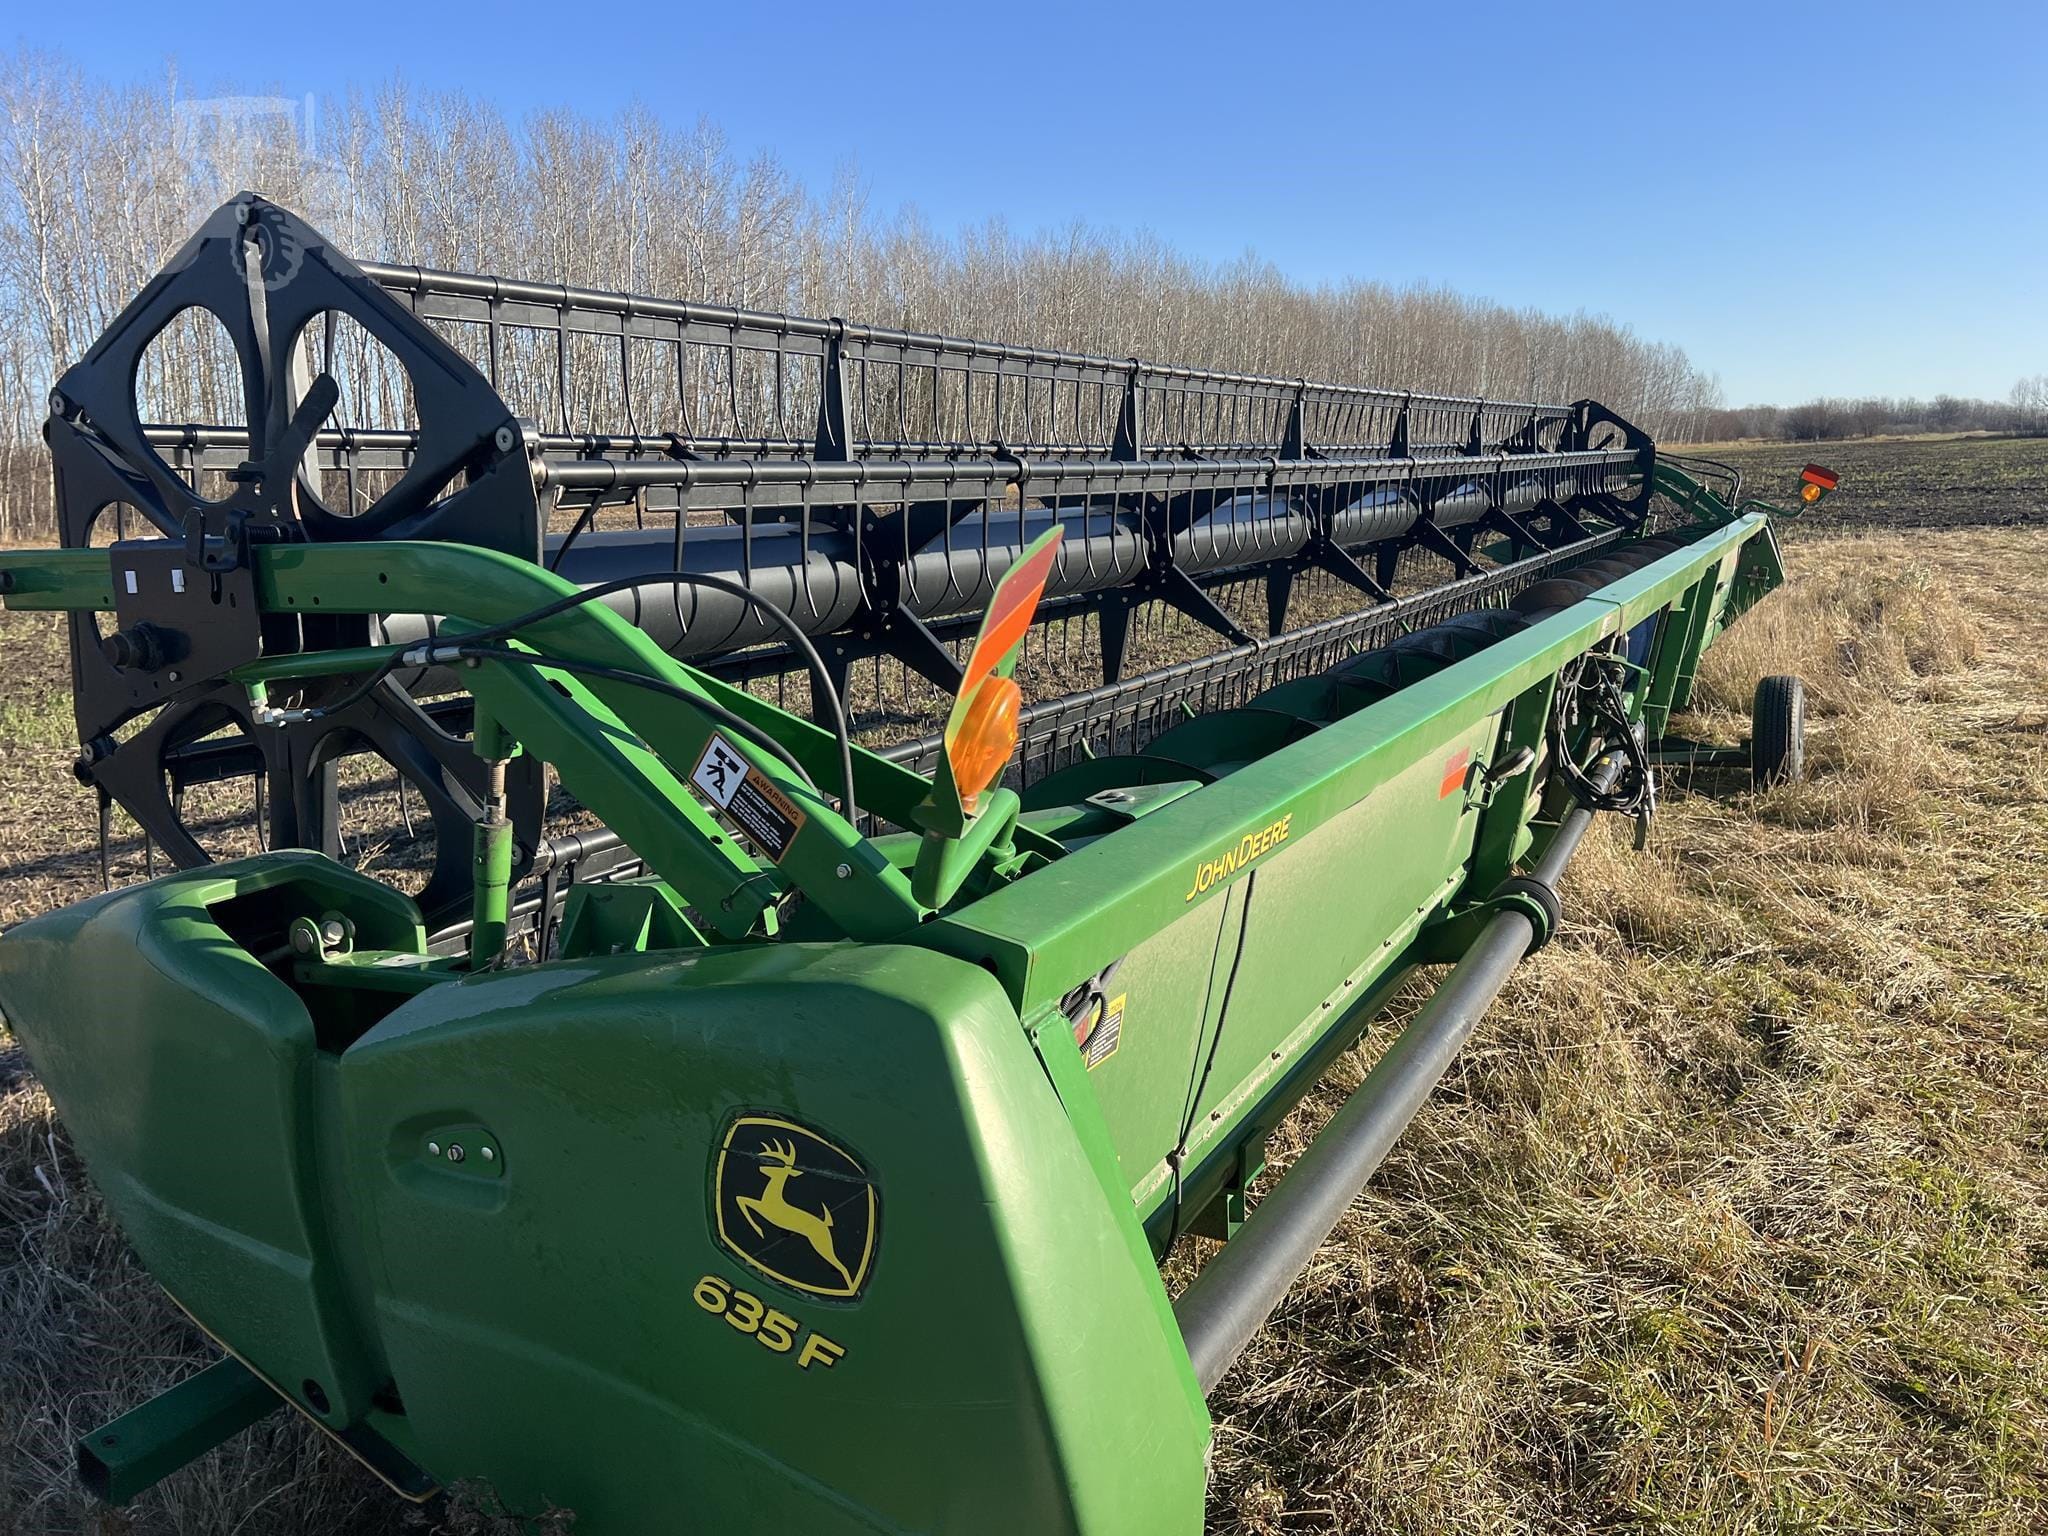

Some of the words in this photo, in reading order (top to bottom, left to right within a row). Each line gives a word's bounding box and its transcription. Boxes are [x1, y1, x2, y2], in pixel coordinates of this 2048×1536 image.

[758, 780, 799, 821] WARNING
[1185, 846, 1239, 903] JOHN
[1236, 812, 1293, 869] DEERE
